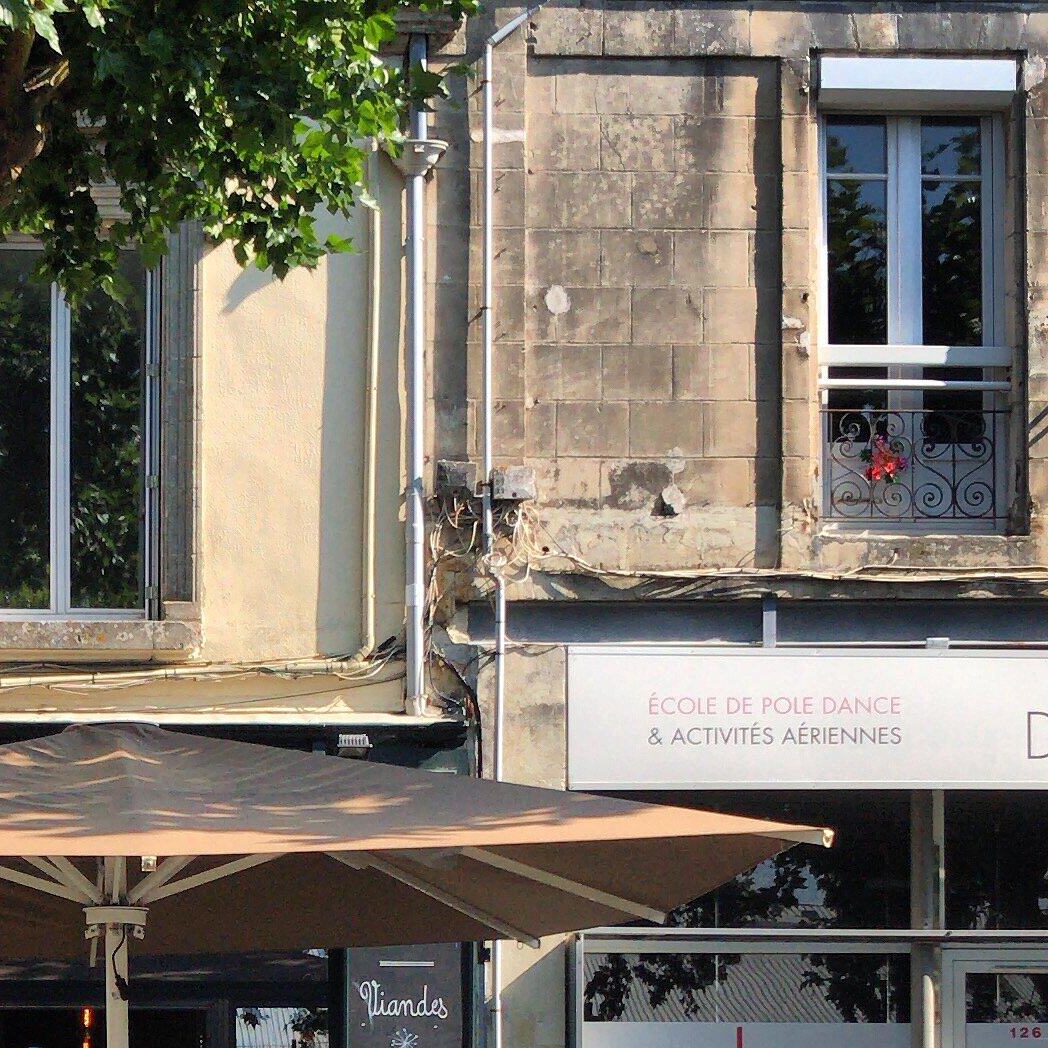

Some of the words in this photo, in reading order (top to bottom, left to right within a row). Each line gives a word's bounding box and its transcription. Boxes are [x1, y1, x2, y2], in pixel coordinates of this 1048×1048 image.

[648, 692, 717, 715] ÉCOLE
[726, 696, 753, 715] DE
[761, 696, 814, 715] POLE
[822, 696, 901, 715] DANCE
[647, 726, 663, 746] &
[670, 721, 774, 746] ACTIVITÉS
[781, 721, 902, 746] AÉRIENNES
[359, 980, 448, 1019] Viandes
[1009, 1026, 1042, 1039] 126
